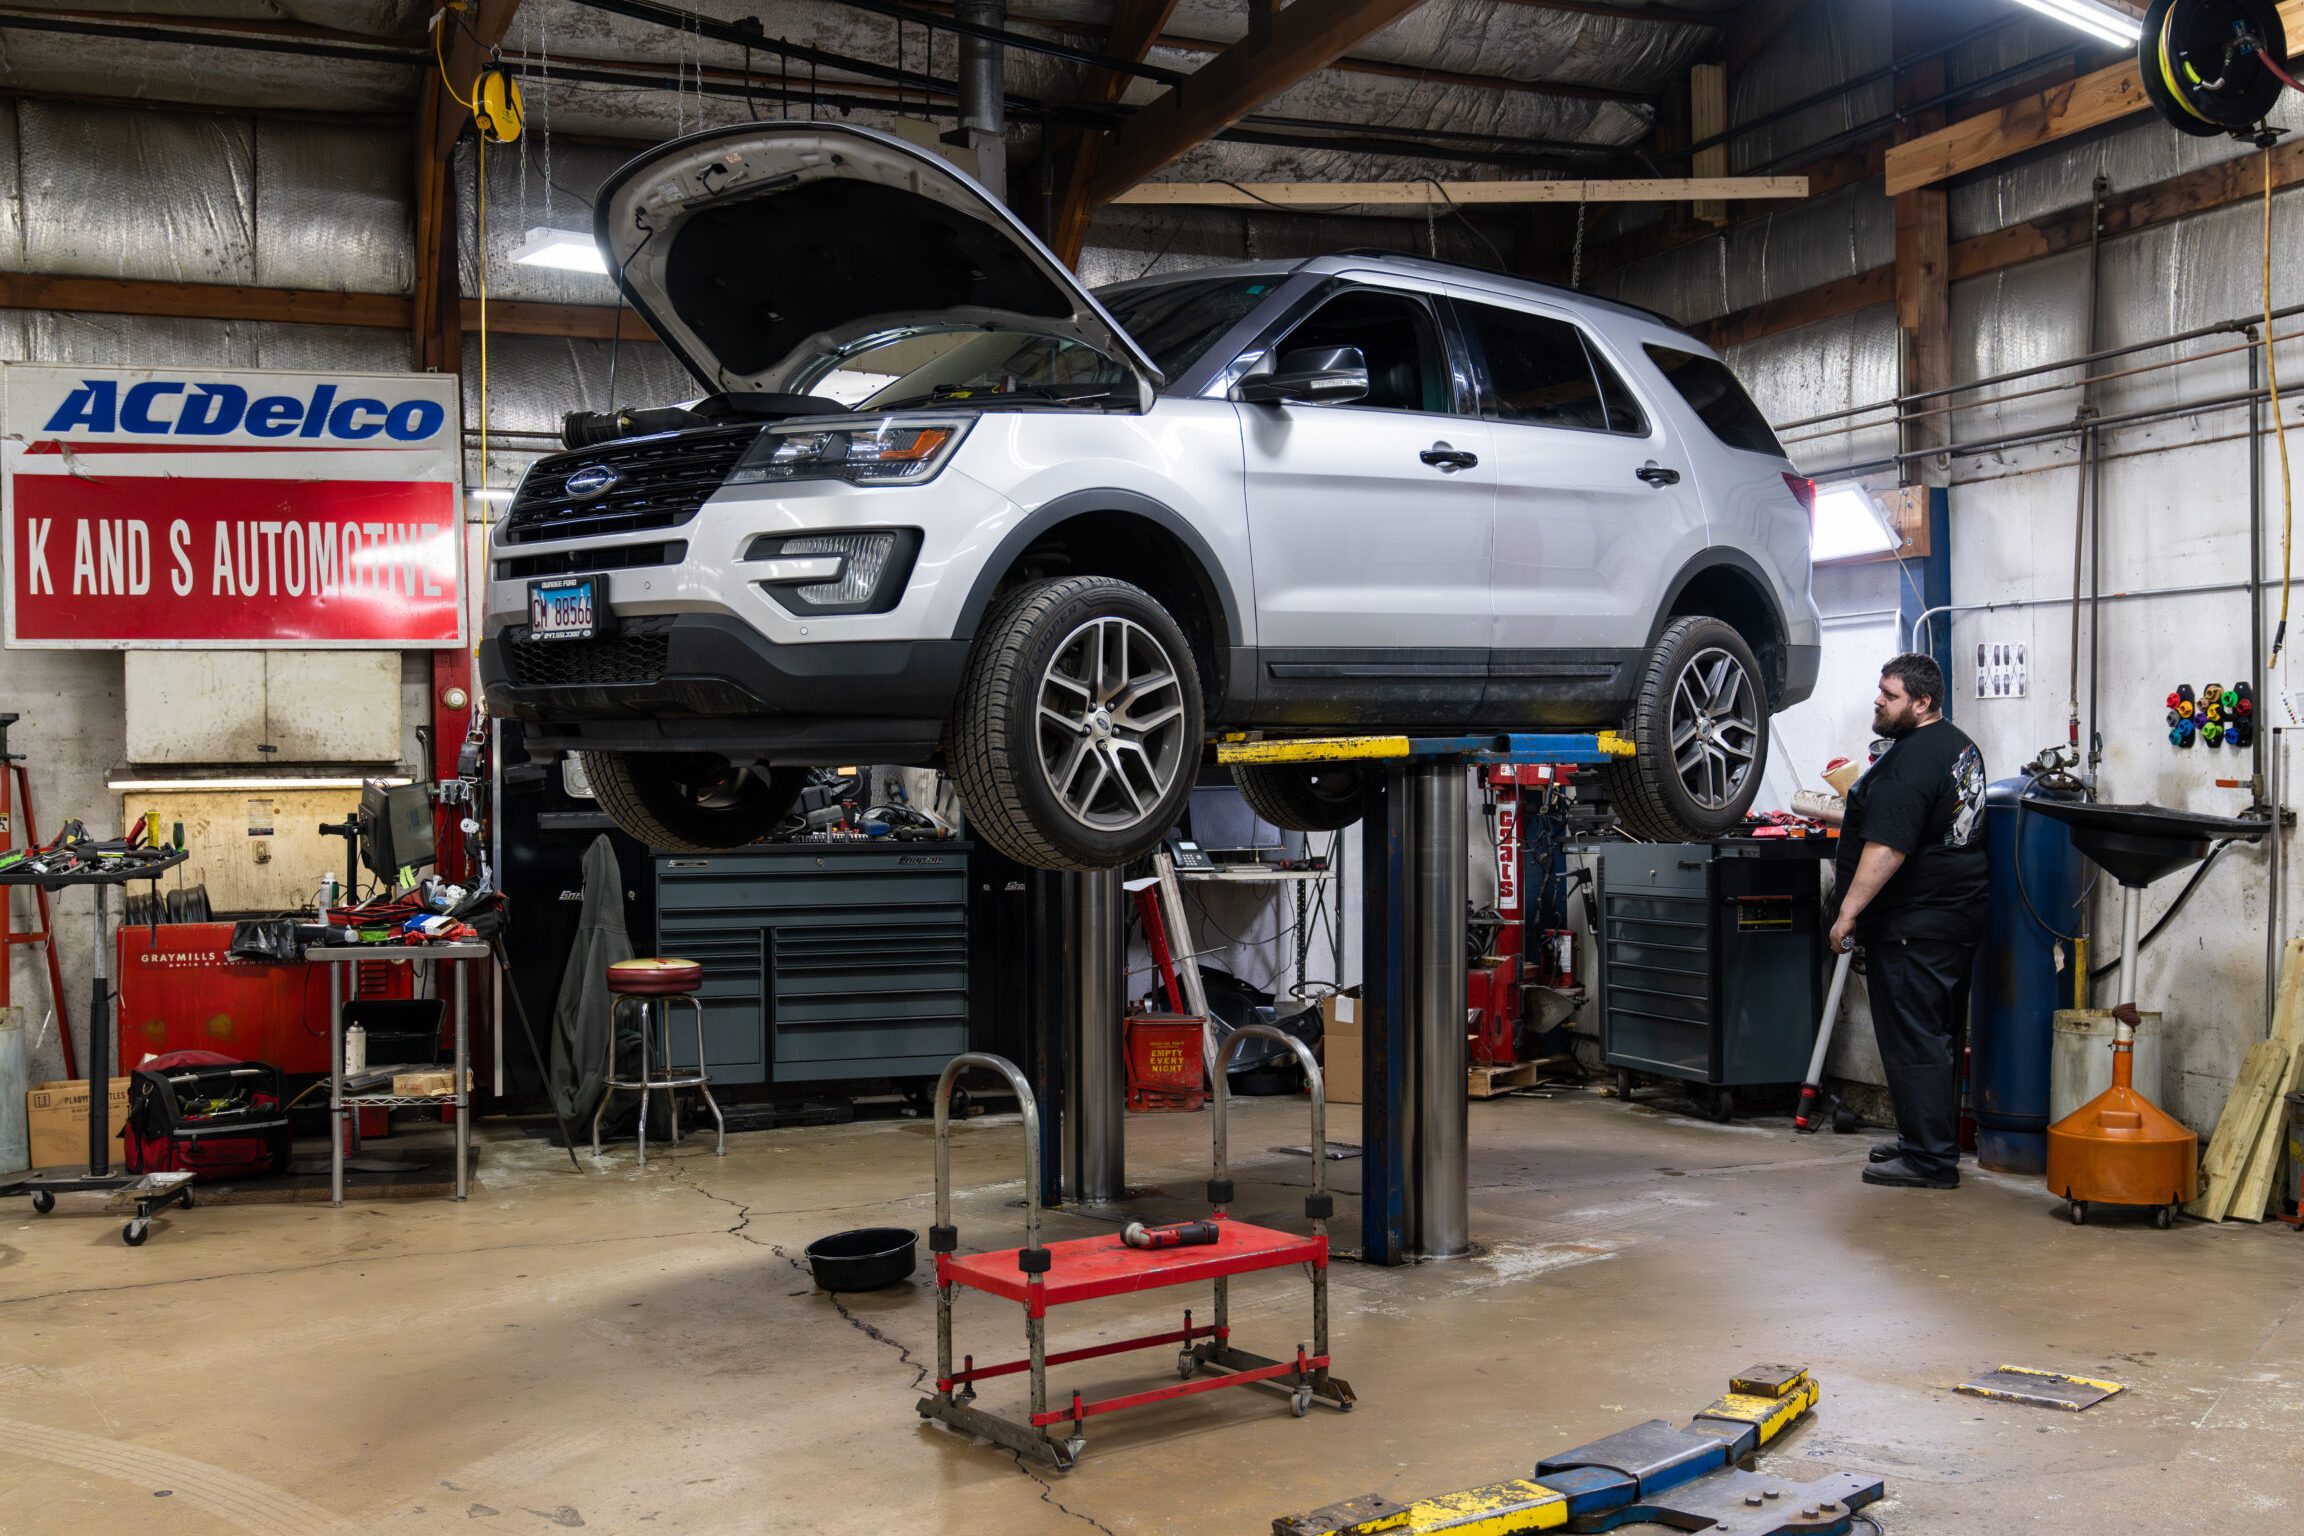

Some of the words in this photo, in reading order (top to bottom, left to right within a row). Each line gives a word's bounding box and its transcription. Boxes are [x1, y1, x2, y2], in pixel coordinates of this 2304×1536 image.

[43, 380, 445, 441] ACDelco
[28, 517, 54, 595] K
[73, 518, 150, 596] AND
[169, 518, 194, 597] S
[212, 519, 442, 598] AUTOMOTIVE
[141, 952, 215, 963] GRAYMILLS
[1151, 1049, 1183, 1057] EMPTY
[1150, 1057, 1184, 1065] EVERY
